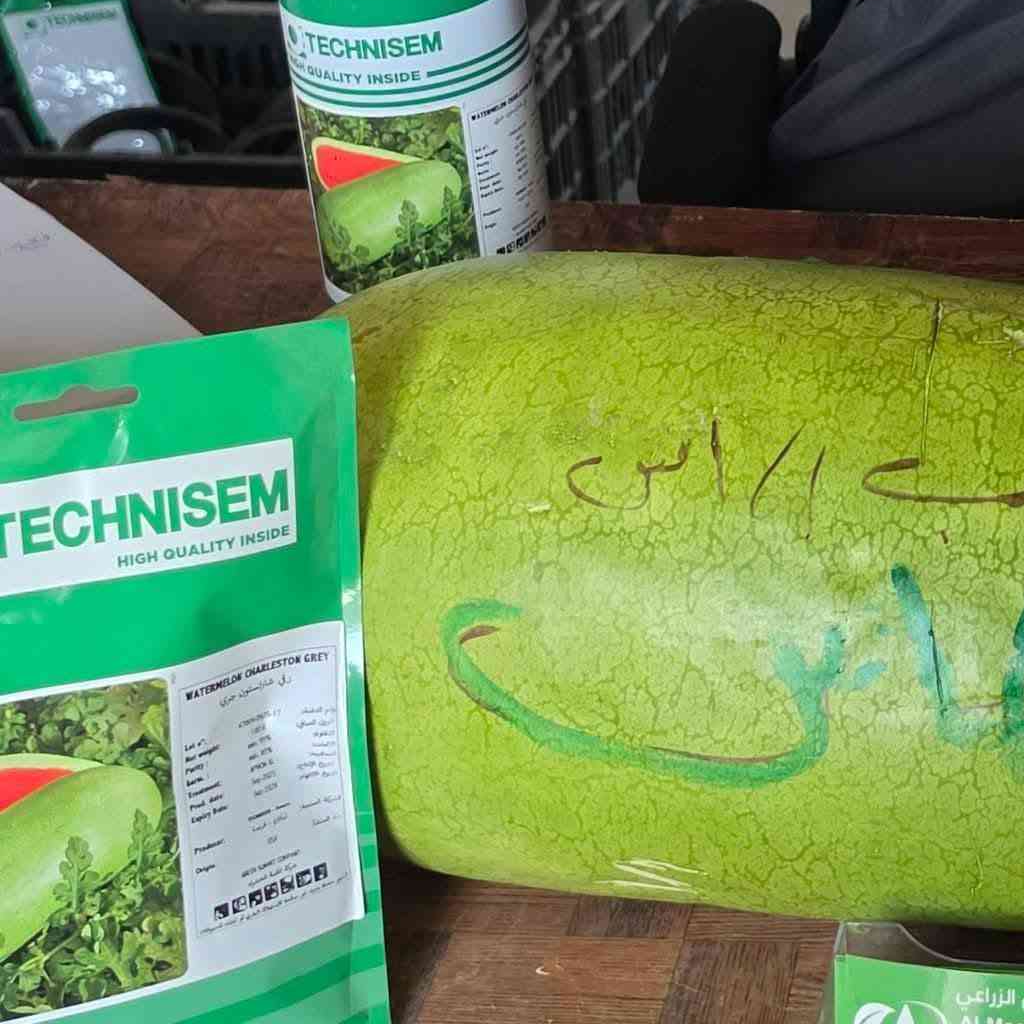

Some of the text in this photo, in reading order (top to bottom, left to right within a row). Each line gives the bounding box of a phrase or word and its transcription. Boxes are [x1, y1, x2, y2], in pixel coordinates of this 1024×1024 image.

[305, 30, 443, 60] TECHNISEM
[306, 65, 362, 84] QUALITY
[367, 70, 421, 85] INSIDE
[0, 468, 290, 559] TECHNISEM
[117, 525, 290, 568] HIGH QUALITY INSIDE
[185, 652, 330, 701] WATERMELON CHARLESTON GREY
[955, 987, 1016, 1012] الزراعي
